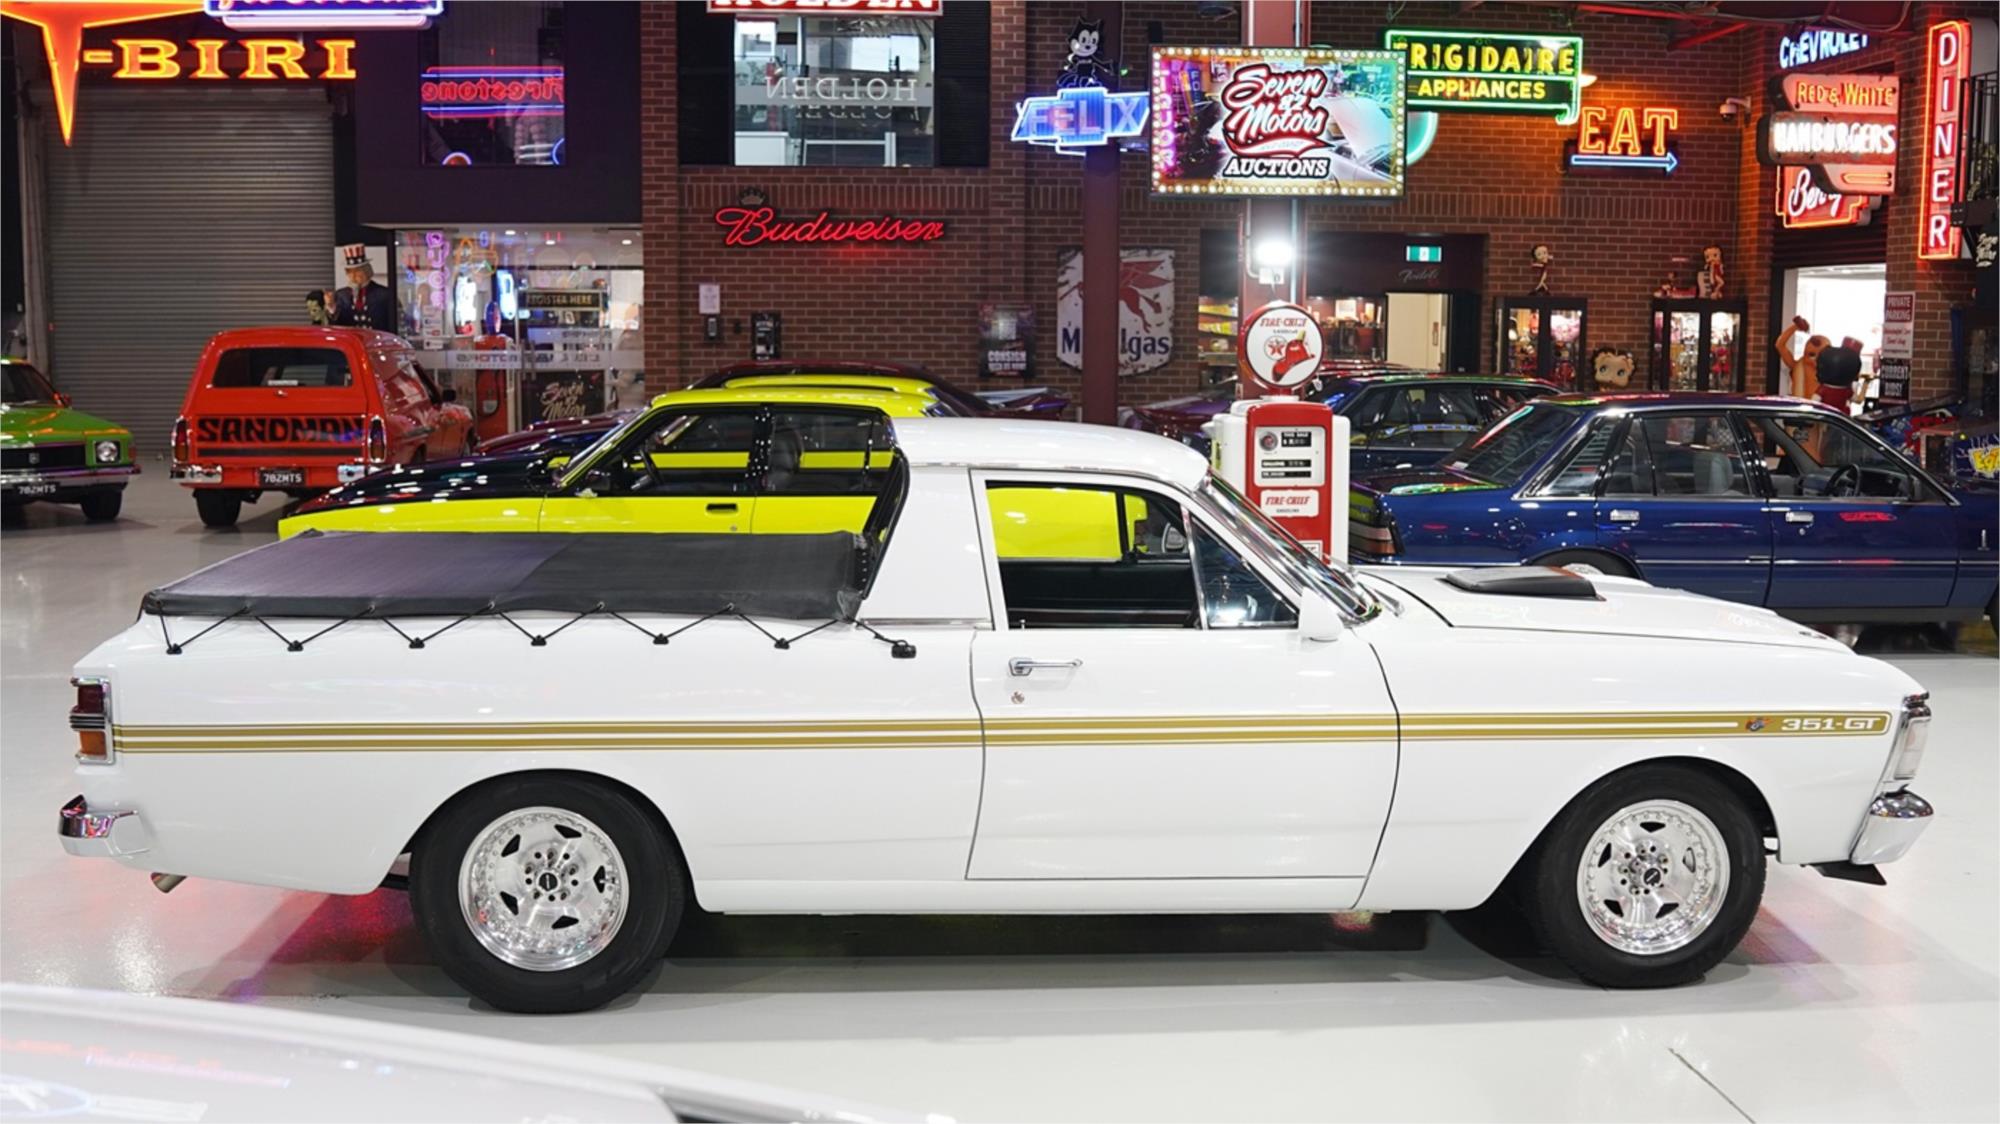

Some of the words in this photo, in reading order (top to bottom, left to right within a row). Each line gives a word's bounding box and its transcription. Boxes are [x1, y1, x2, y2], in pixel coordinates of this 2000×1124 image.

[1393, 42, 1575, 75] RIGIDAIRE
[1226, 67, 1323, 108] Seven
[1418, 78, 1546, 100] APPLIANCES
[1797, 82, 1826, 103] RED
[1828, 87, 1840, 107] &
[1842, 83, 1895, 106] WHITE
[1027, 99, 1141, 136] FELIX
[1226, 102, 1326, 143] Motors
[1578, 106, 1679, 156] EAT
[1773, 122, 1897, 154] HAMBURGERS
[1929, 31, 1957, 248] DINER
[1224, 157, 1328, 177] AUCTIONS
[715, 207, 945, 246] Budweiser
[197, 417, 365, 442] SANDMAN
[1781, 717, 1881, 732] 351-GT
